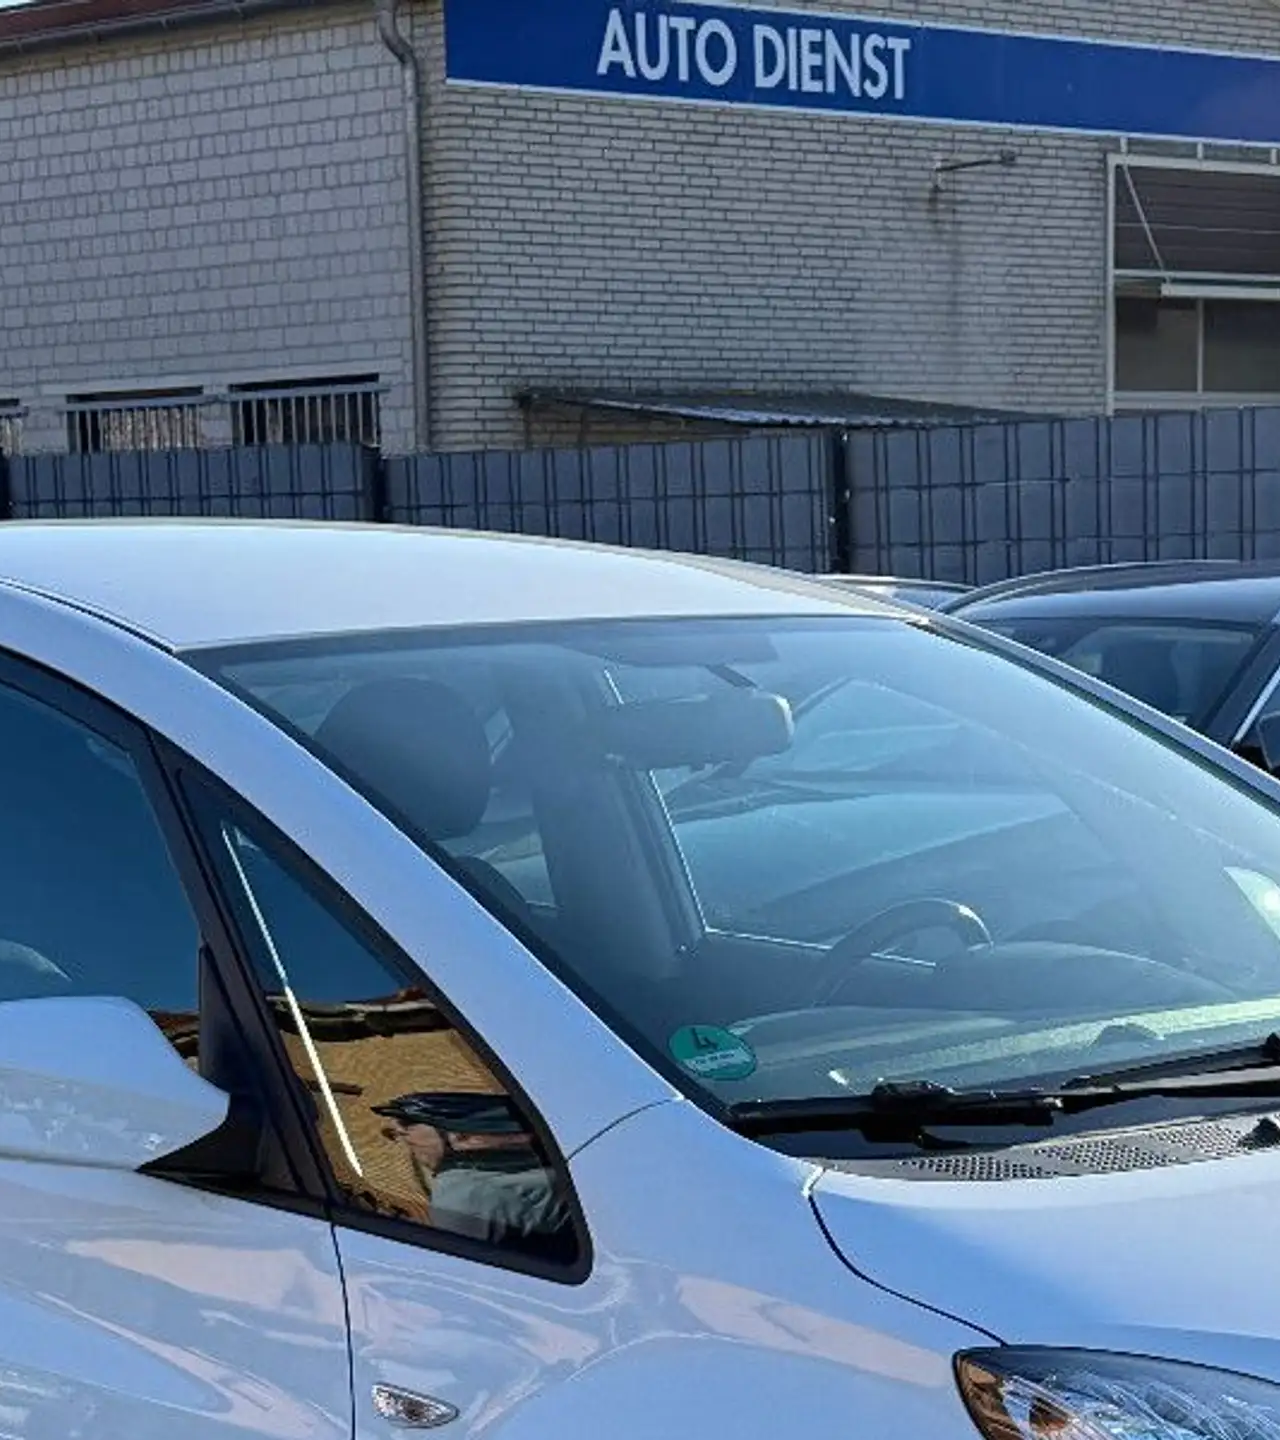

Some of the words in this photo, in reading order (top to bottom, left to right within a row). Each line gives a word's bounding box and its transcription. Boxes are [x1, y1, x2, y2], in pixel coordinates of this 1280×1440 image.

[596, 8, 738, 87] AUTO
[753, 24, 911, 100] DIENST
[690, 1027, 718, 1053] 4
